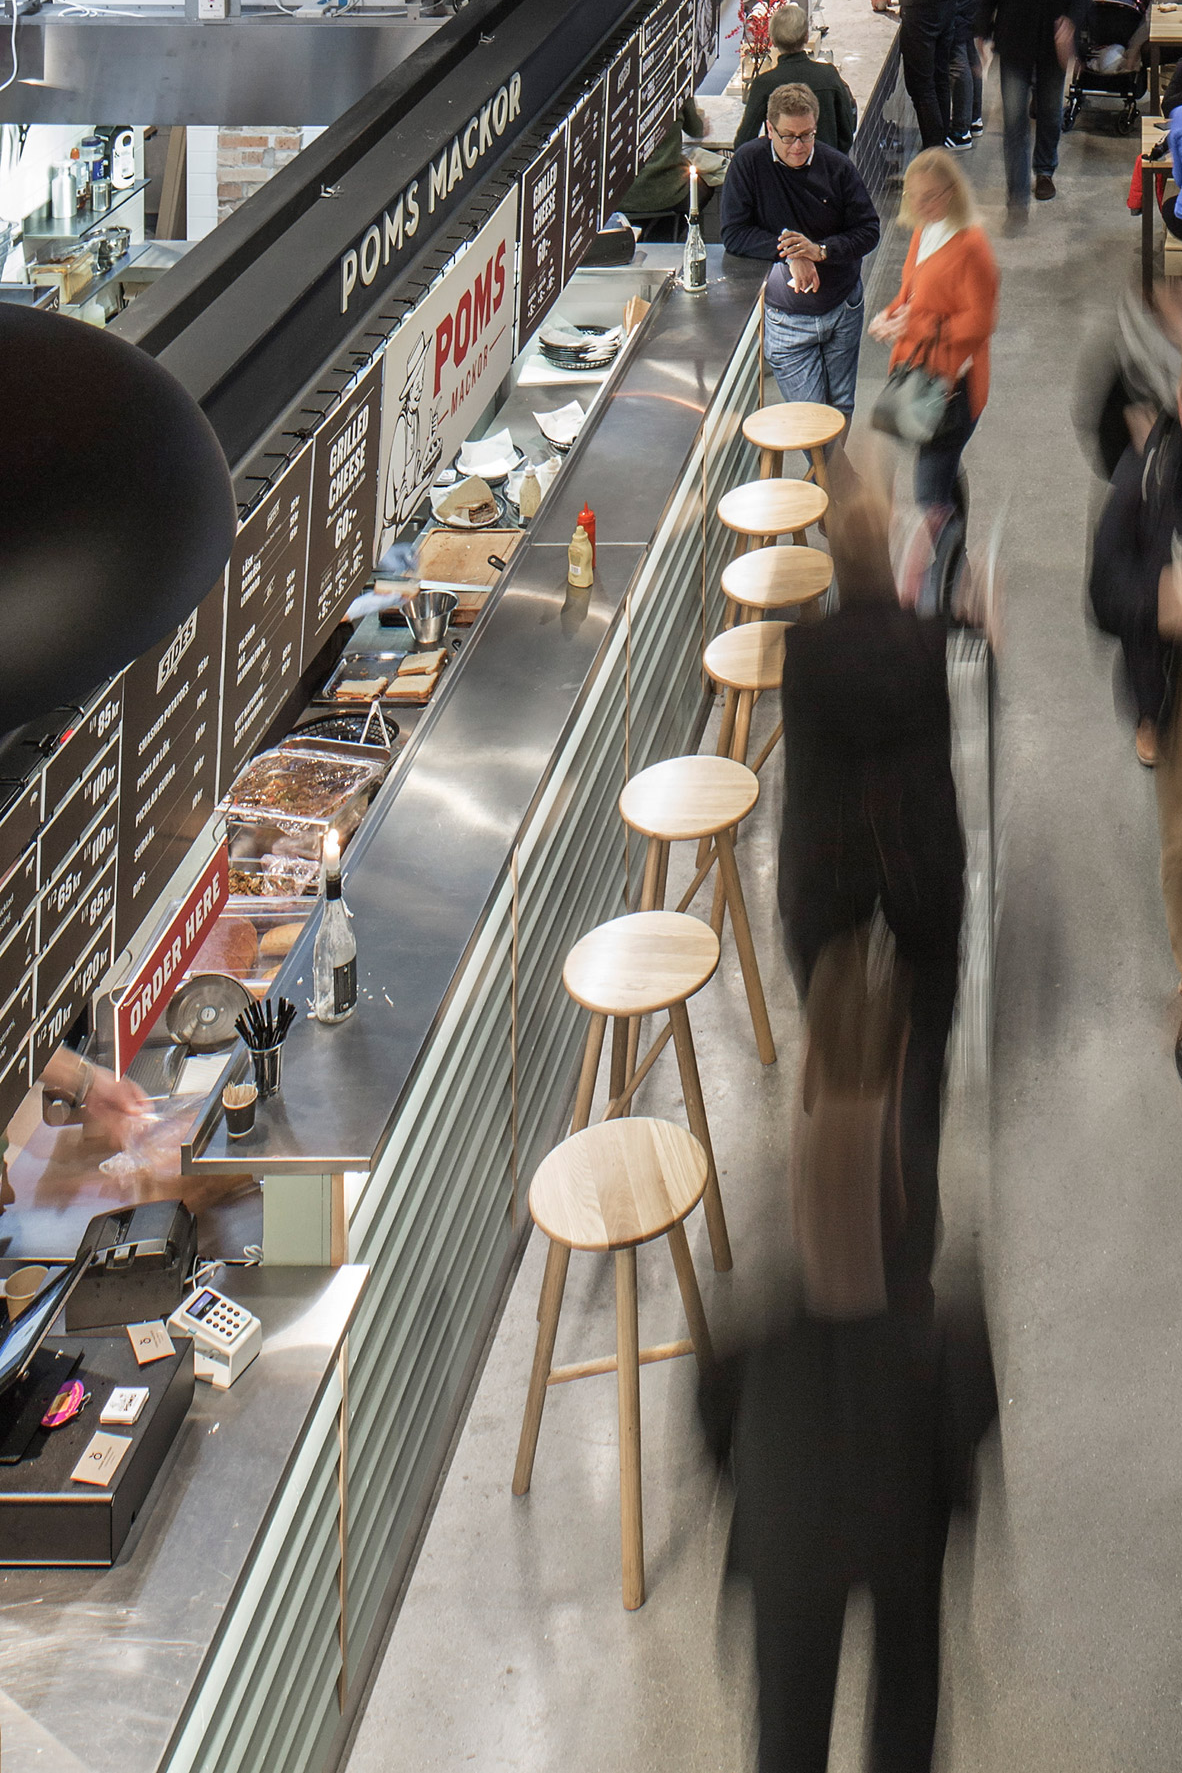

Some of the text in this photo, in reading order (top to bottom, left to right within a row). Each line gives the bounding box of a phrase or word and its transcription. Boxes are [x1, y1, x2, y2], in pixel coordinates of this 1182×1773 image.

[340, 71, 522, 314] POMS MACKOR
[432, 238, 506, 400] POMS
[450, 344, 488, 418] MACKOR
[328, 439, 366, 510] CHEESE
[329, 405, 369, 476] GRILLED
[160, 618, 194, 681] SIDES
[130, 871, 220, 1037] ORDER HERE
